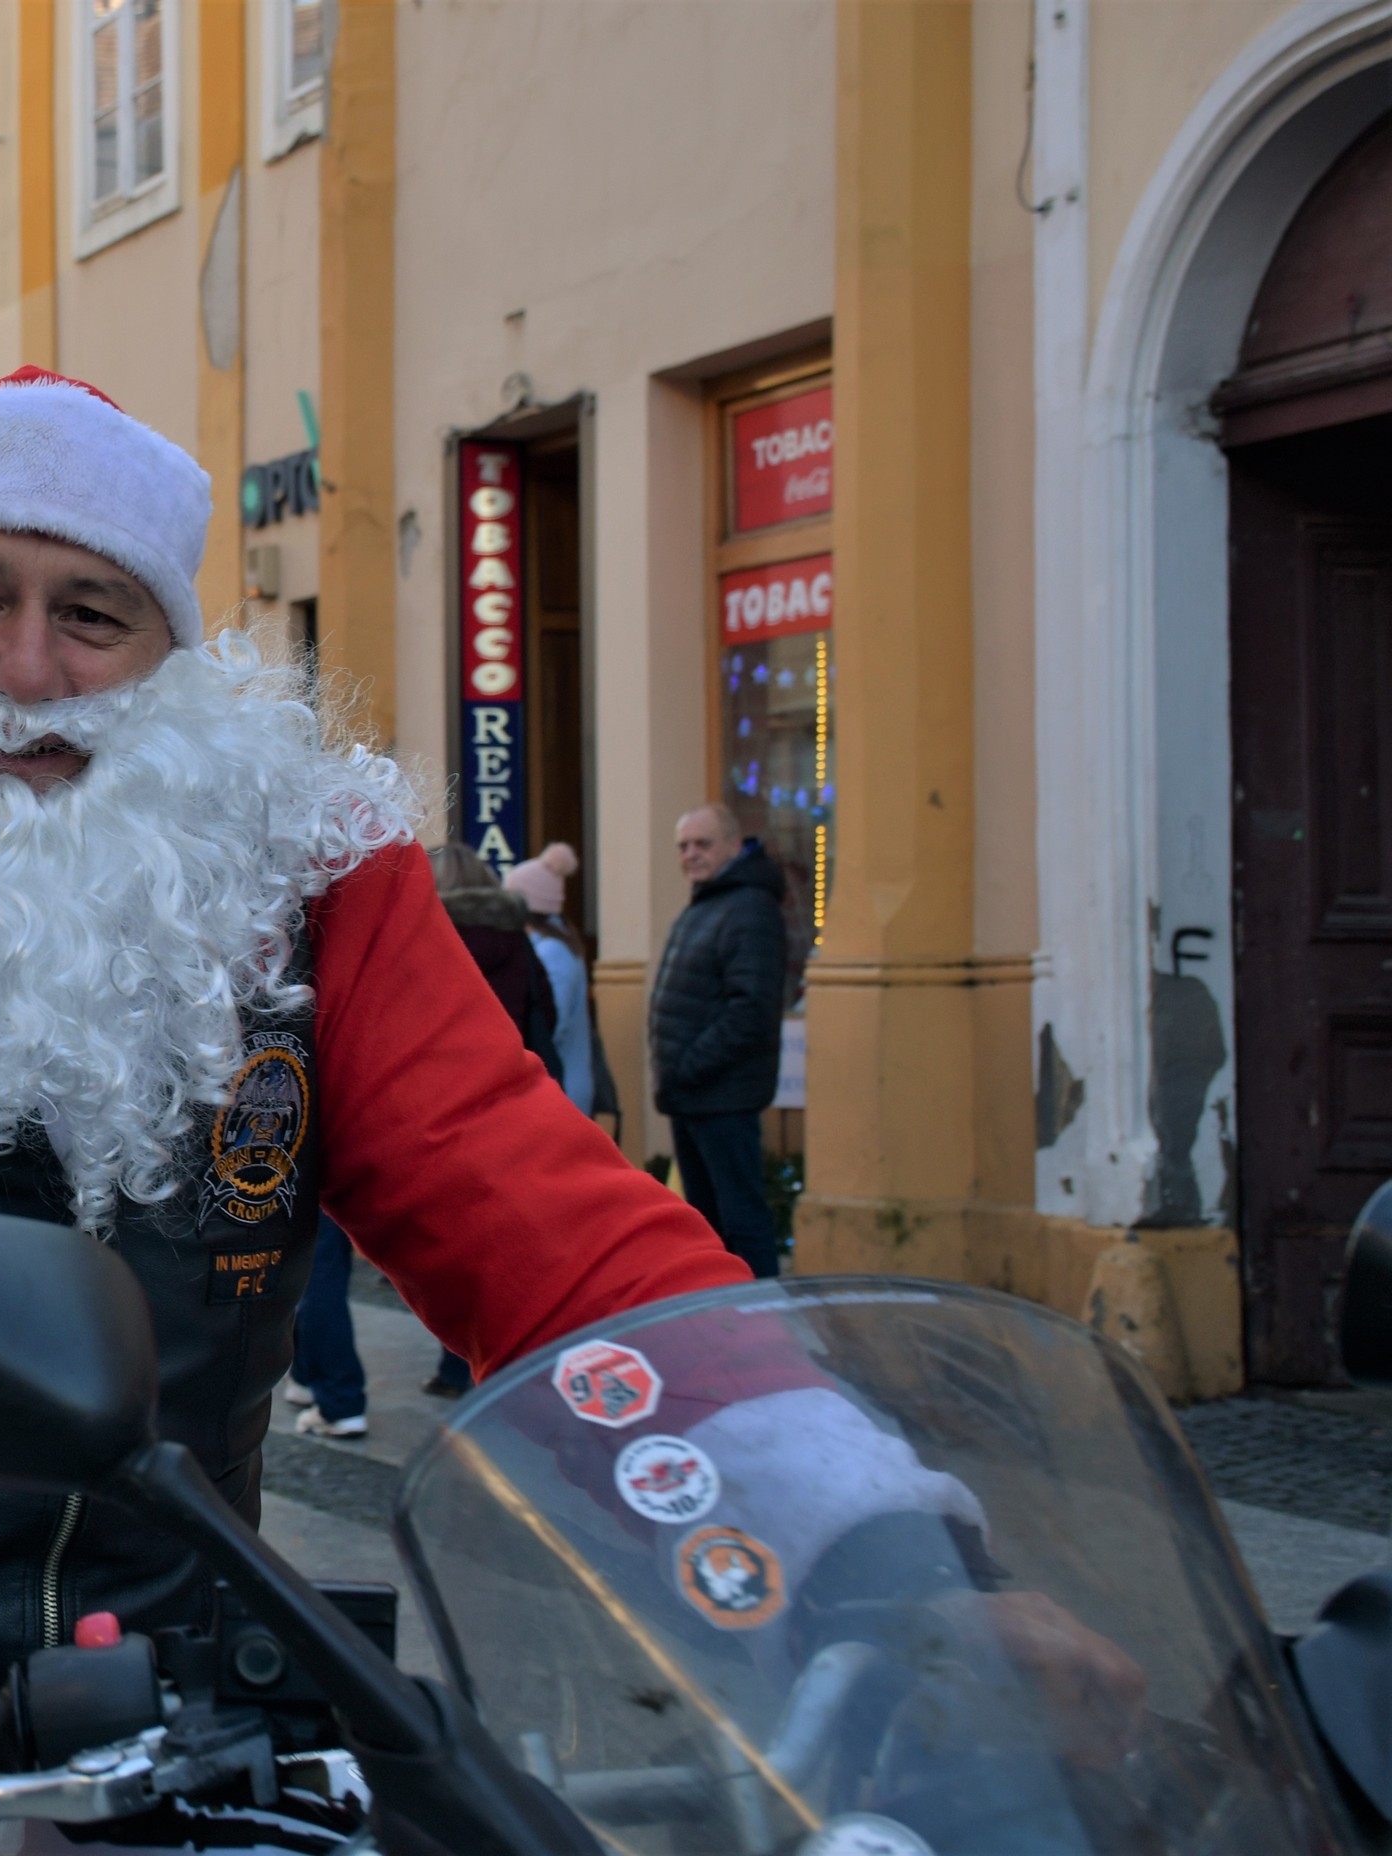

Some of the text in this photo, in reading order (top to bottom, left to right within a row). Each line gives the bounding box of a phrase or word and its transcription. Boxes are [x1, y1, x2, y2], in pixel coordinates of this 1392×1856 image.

[468, 452, 516, 696] TOBACCO
[724, 571, 833, 632] TOBAC
[227, 1199, 279, 1221] CROATIA
[215, 1255, 228, 1271] IN
